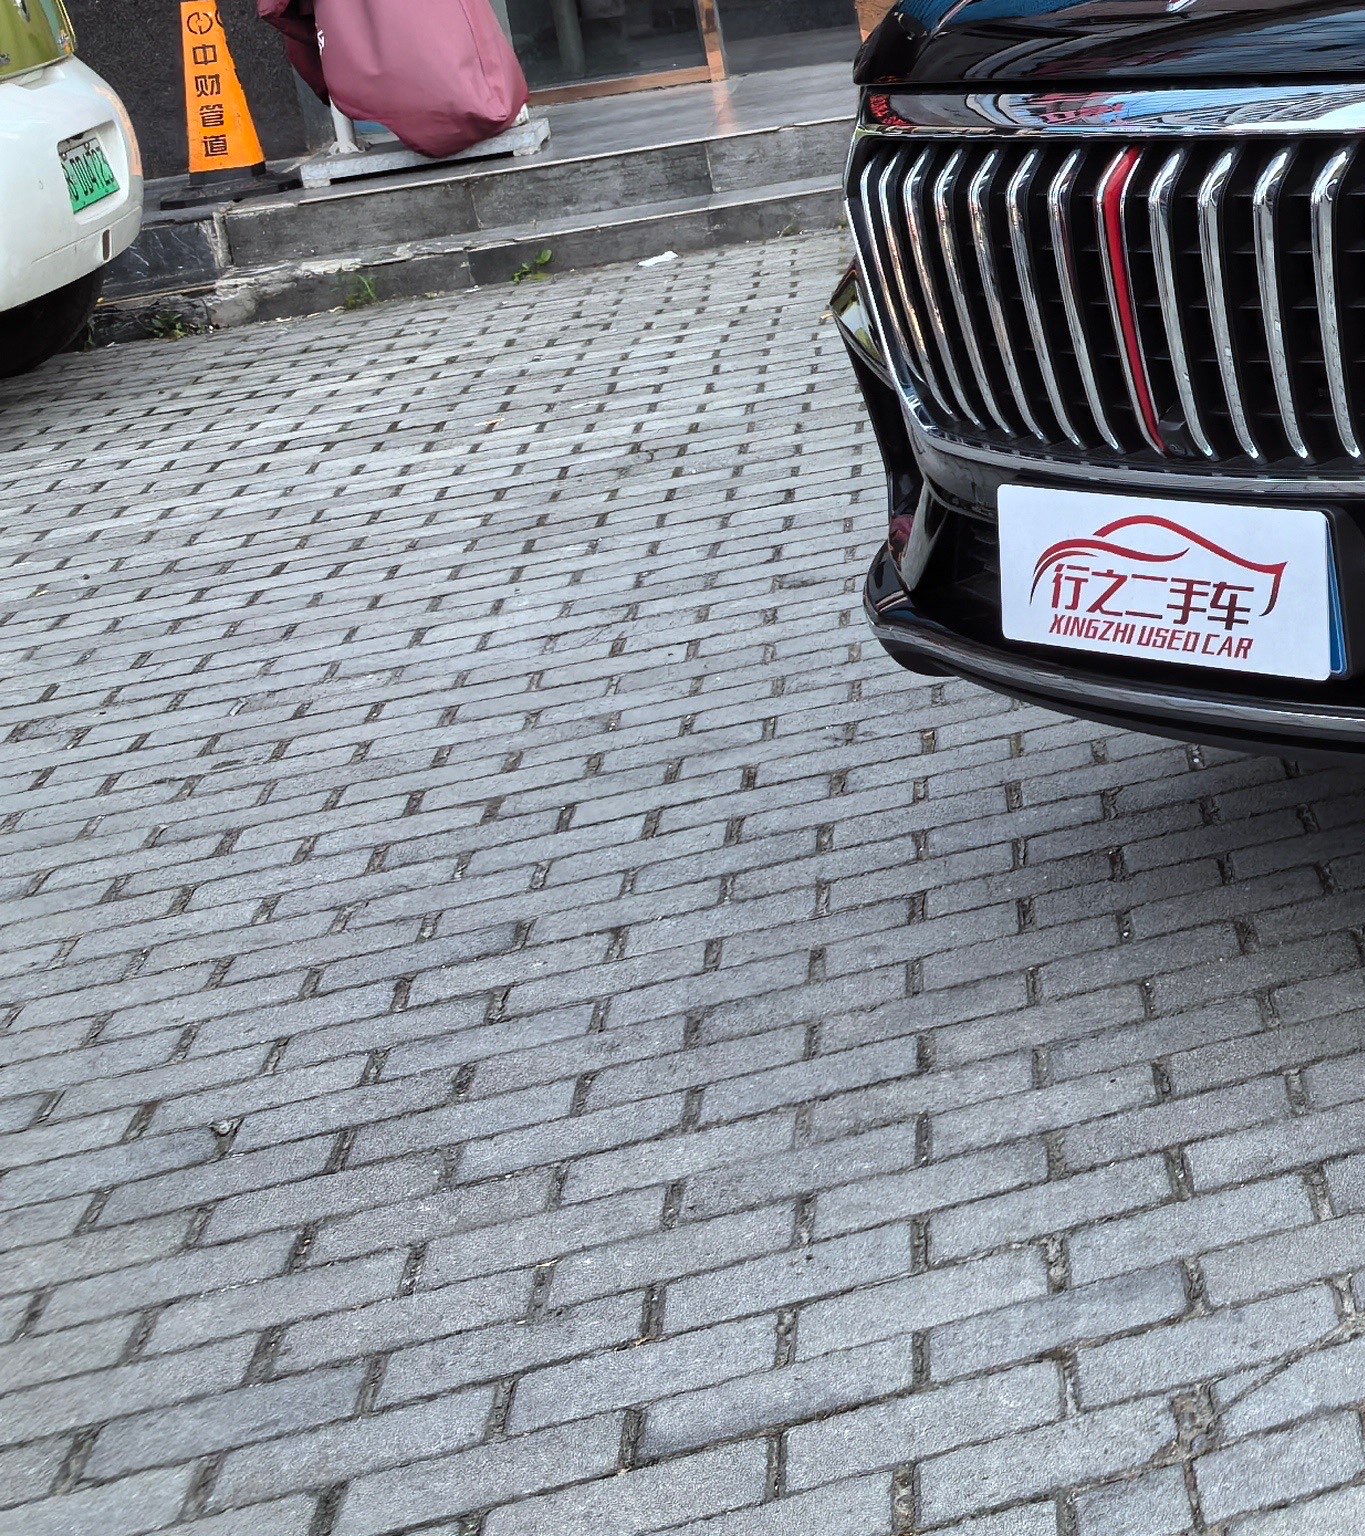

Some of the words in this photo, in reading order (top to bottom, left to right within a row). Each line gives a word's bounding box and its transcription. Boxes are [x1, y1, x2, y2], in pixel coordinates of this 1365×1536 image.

[192, 42, 230, 157] 中财管道
[1051, 563, 1255, 631] 行之二手车
[1049, 614, 1136, 645] XINGZHI
[1137, 625, 1202, 653] USED
[1202, 633, 1254, 659] CAR
